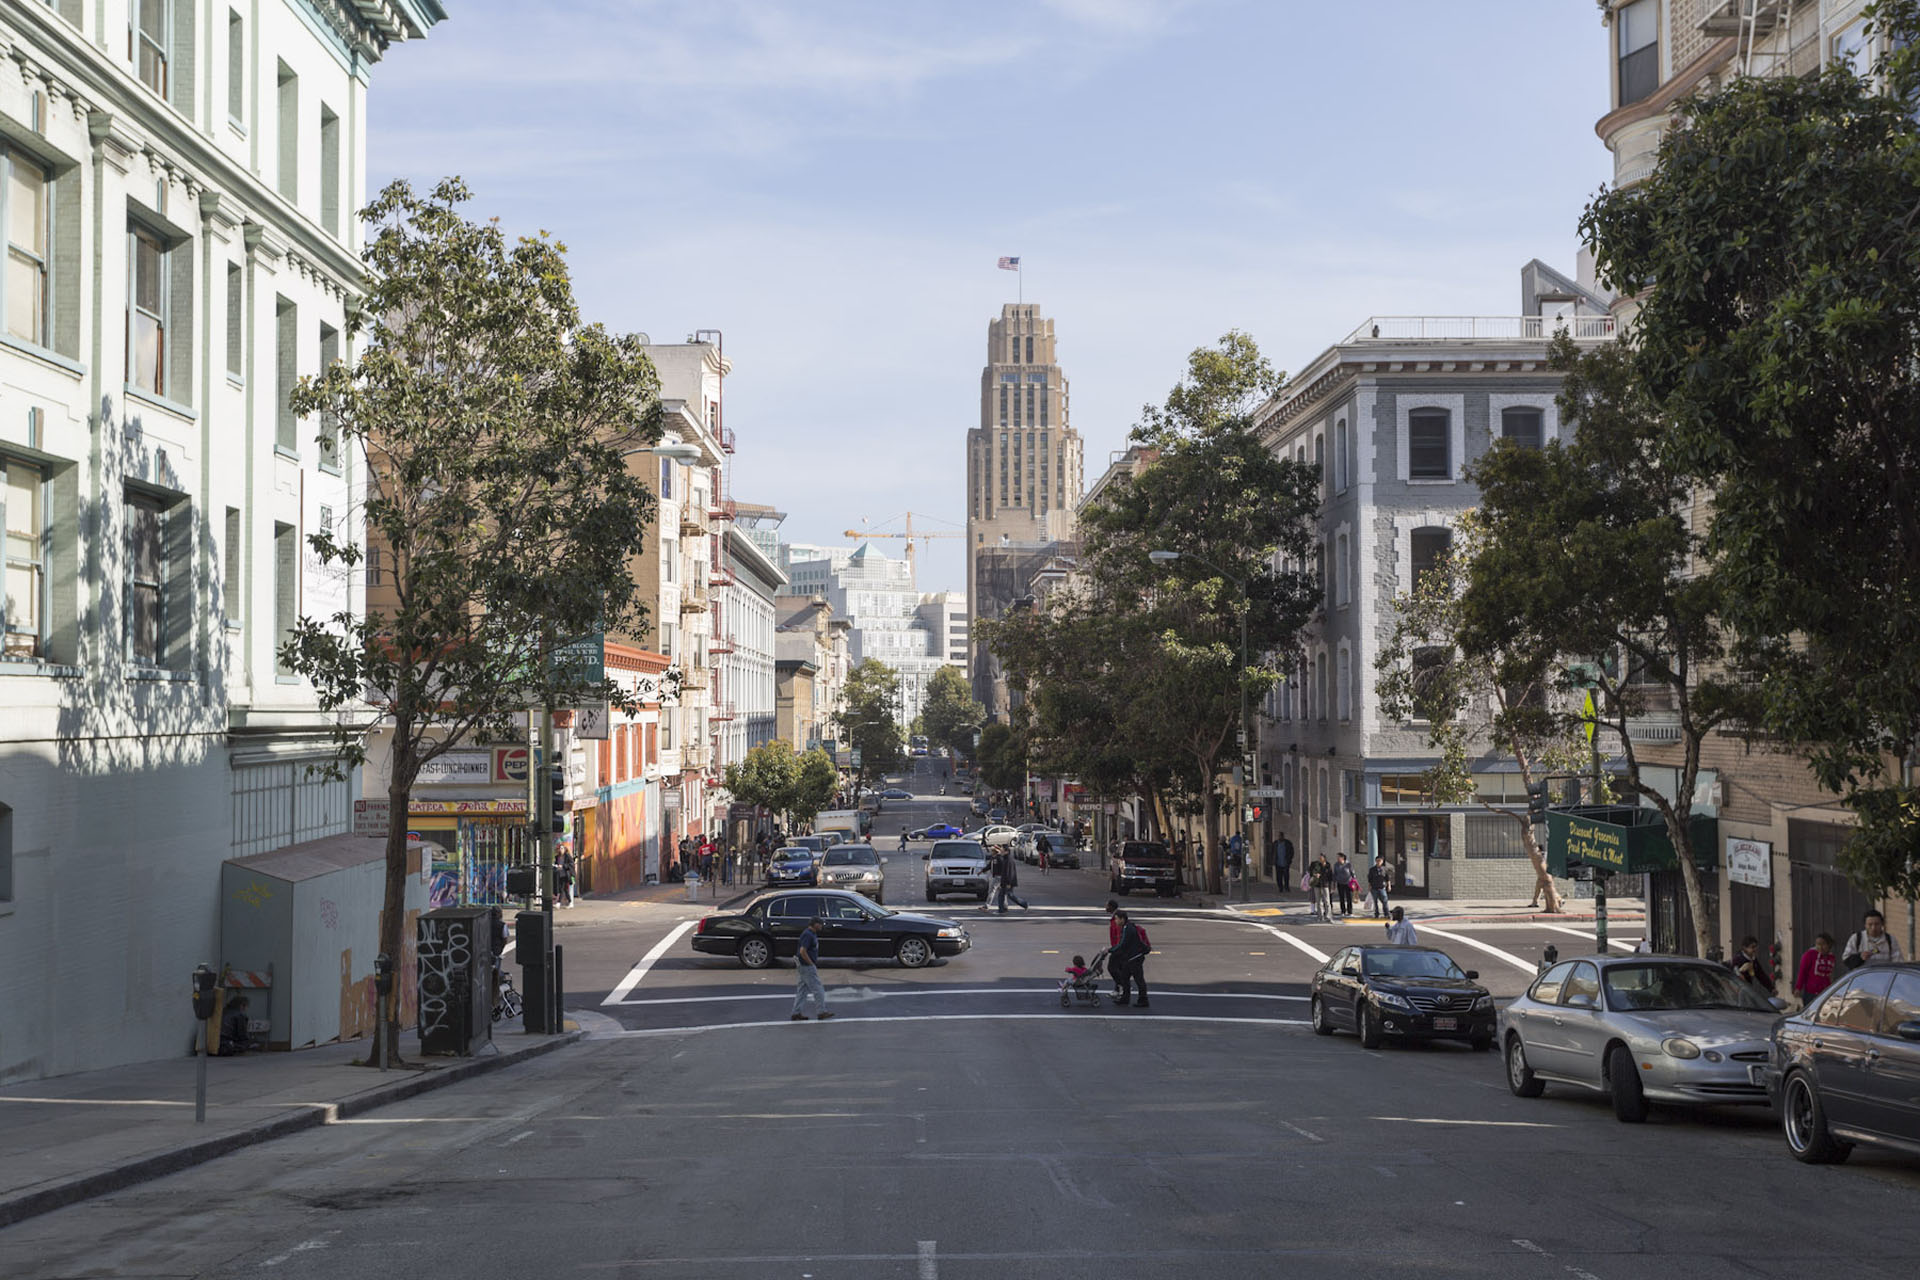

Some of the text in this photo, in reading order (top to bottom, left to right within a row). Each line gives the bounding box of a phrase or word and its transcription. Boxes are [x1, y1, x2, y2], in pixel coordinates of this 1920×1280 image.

[504, 760, 528, 769] PEP
[1569, 821, 1620, 846] Discount Groceries
